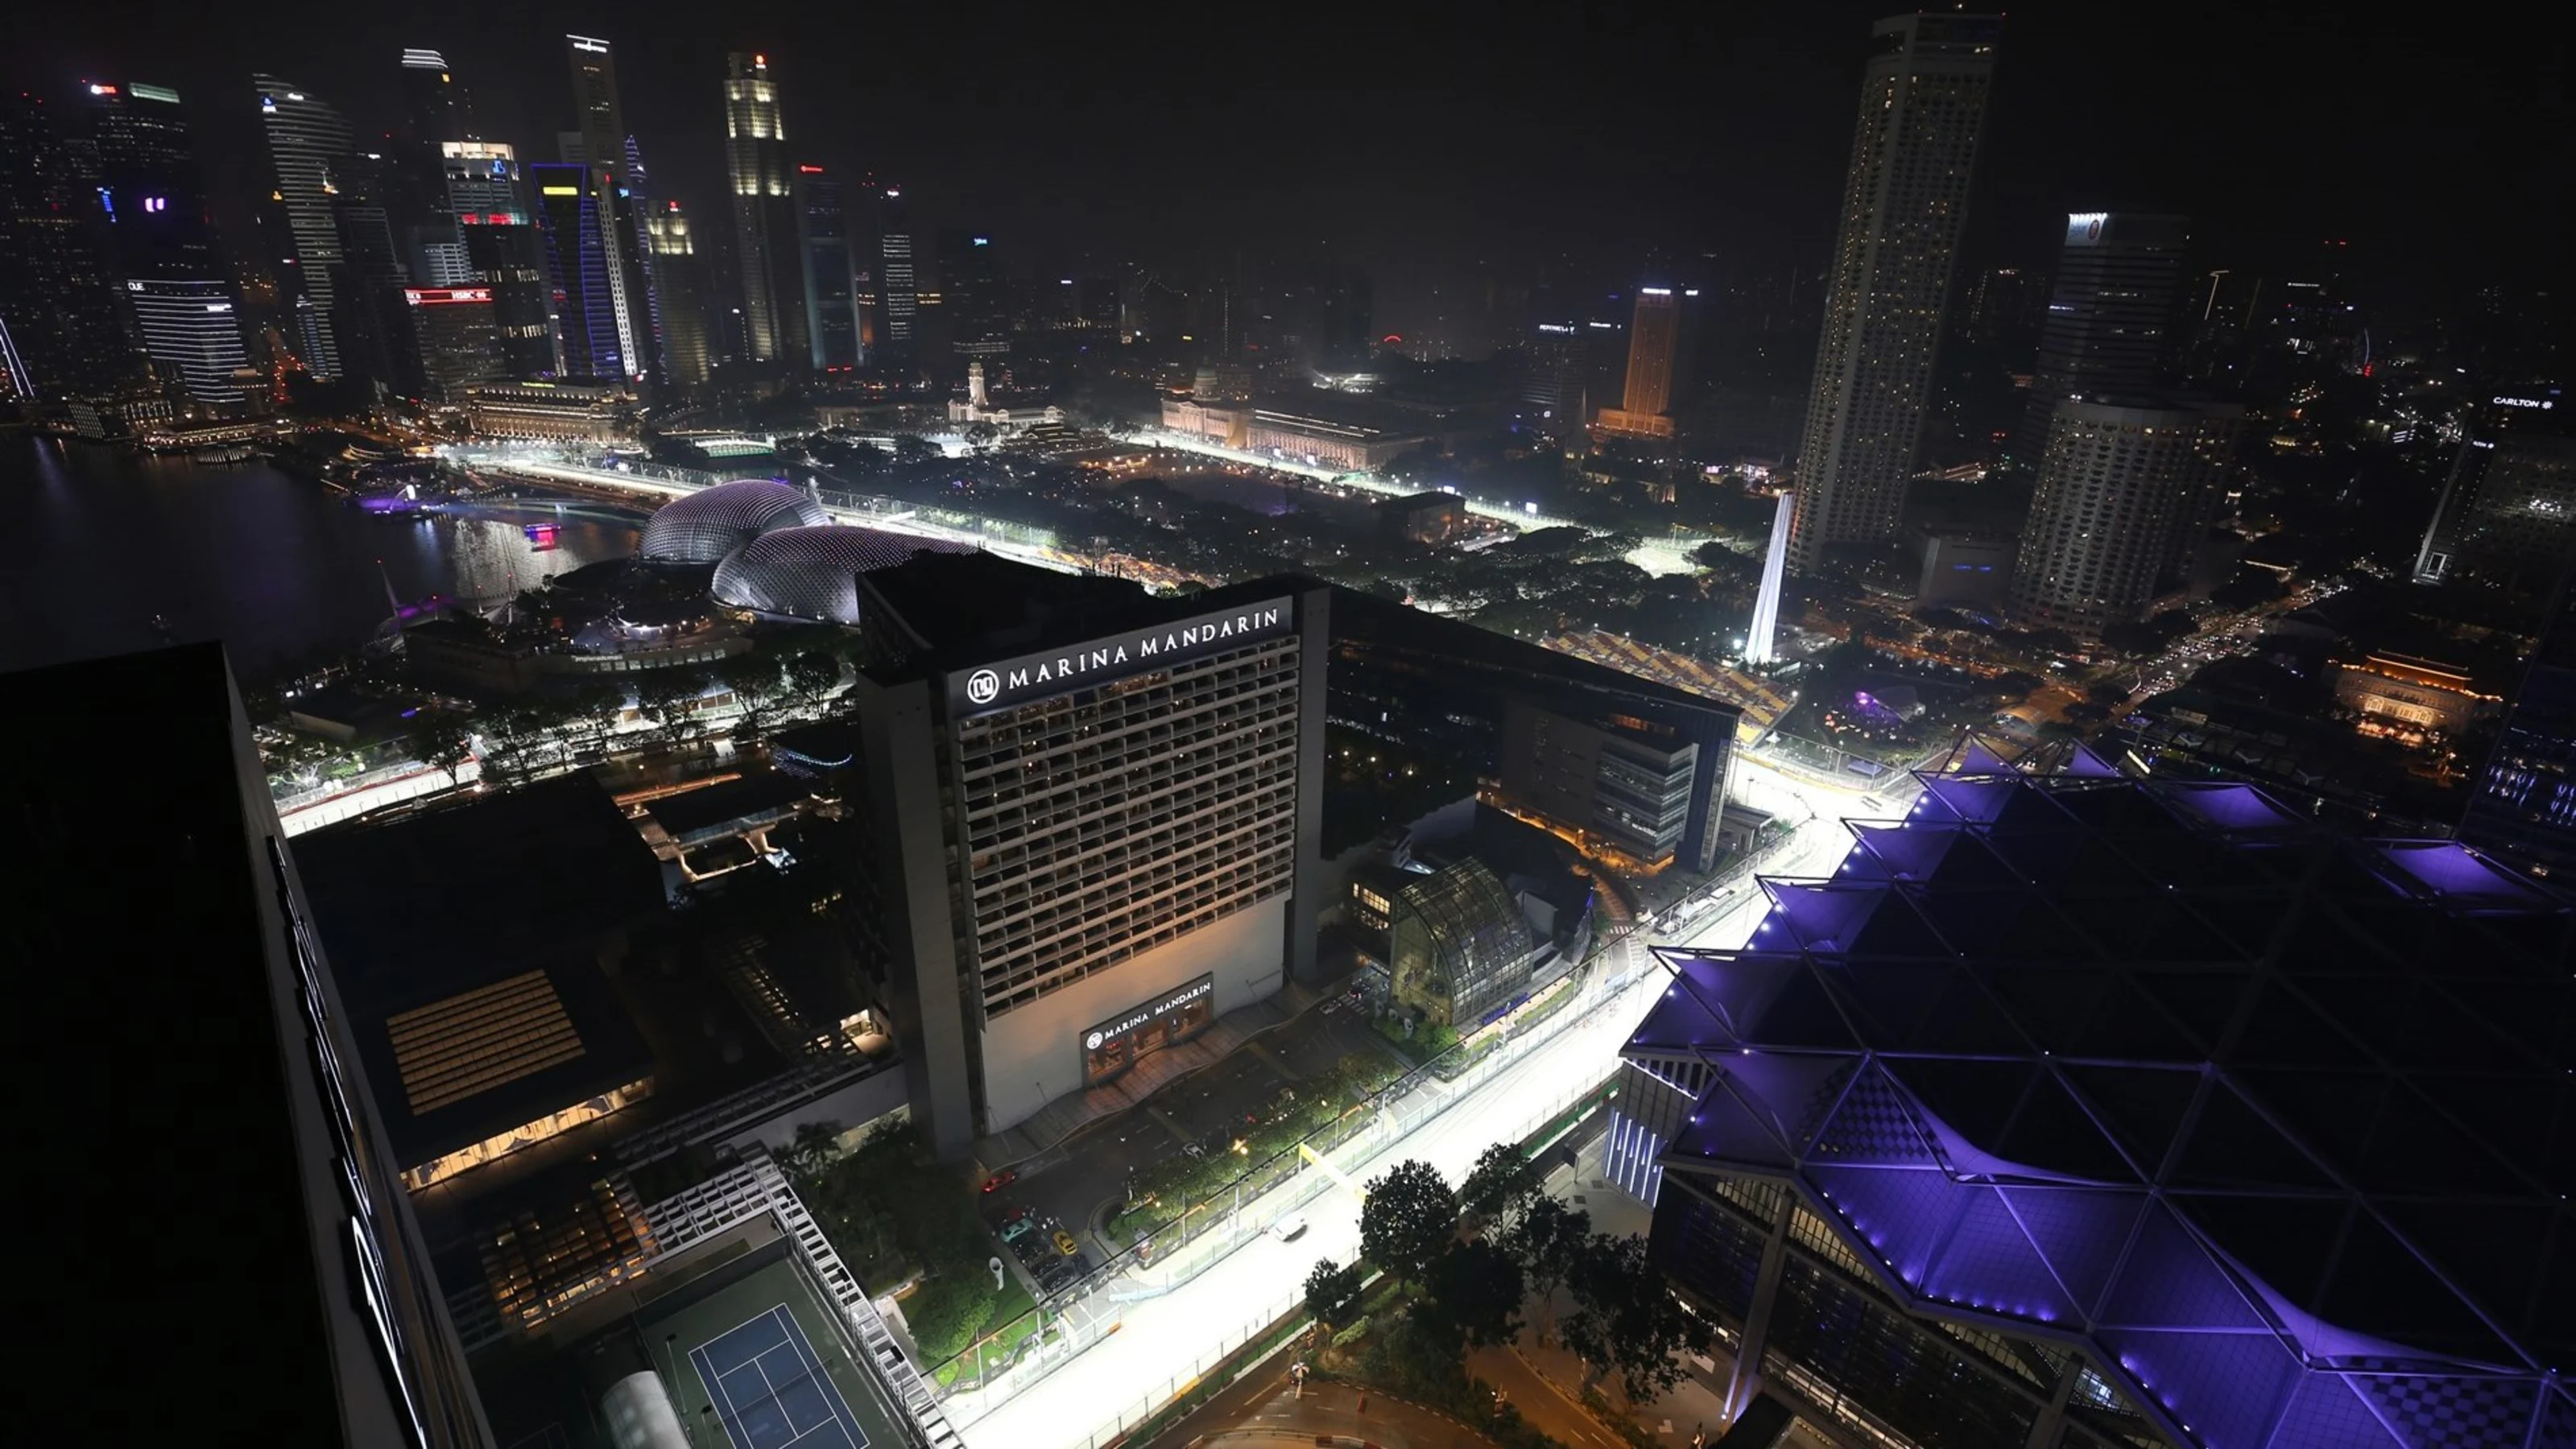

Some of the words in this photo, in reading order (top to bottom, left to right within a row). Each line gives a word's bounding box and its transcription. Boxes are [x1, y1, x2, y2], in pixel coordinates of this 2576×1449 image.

[2493, 397, 2540, 407] CARLTON
[1009, 645, 1128, 689] MARINA
[1140, 609, 1278, 657] MANDARIN
[1105, 1013, 1149, 1039] MARINA
[1155, 982, 1211, 1016] MANDARIN
